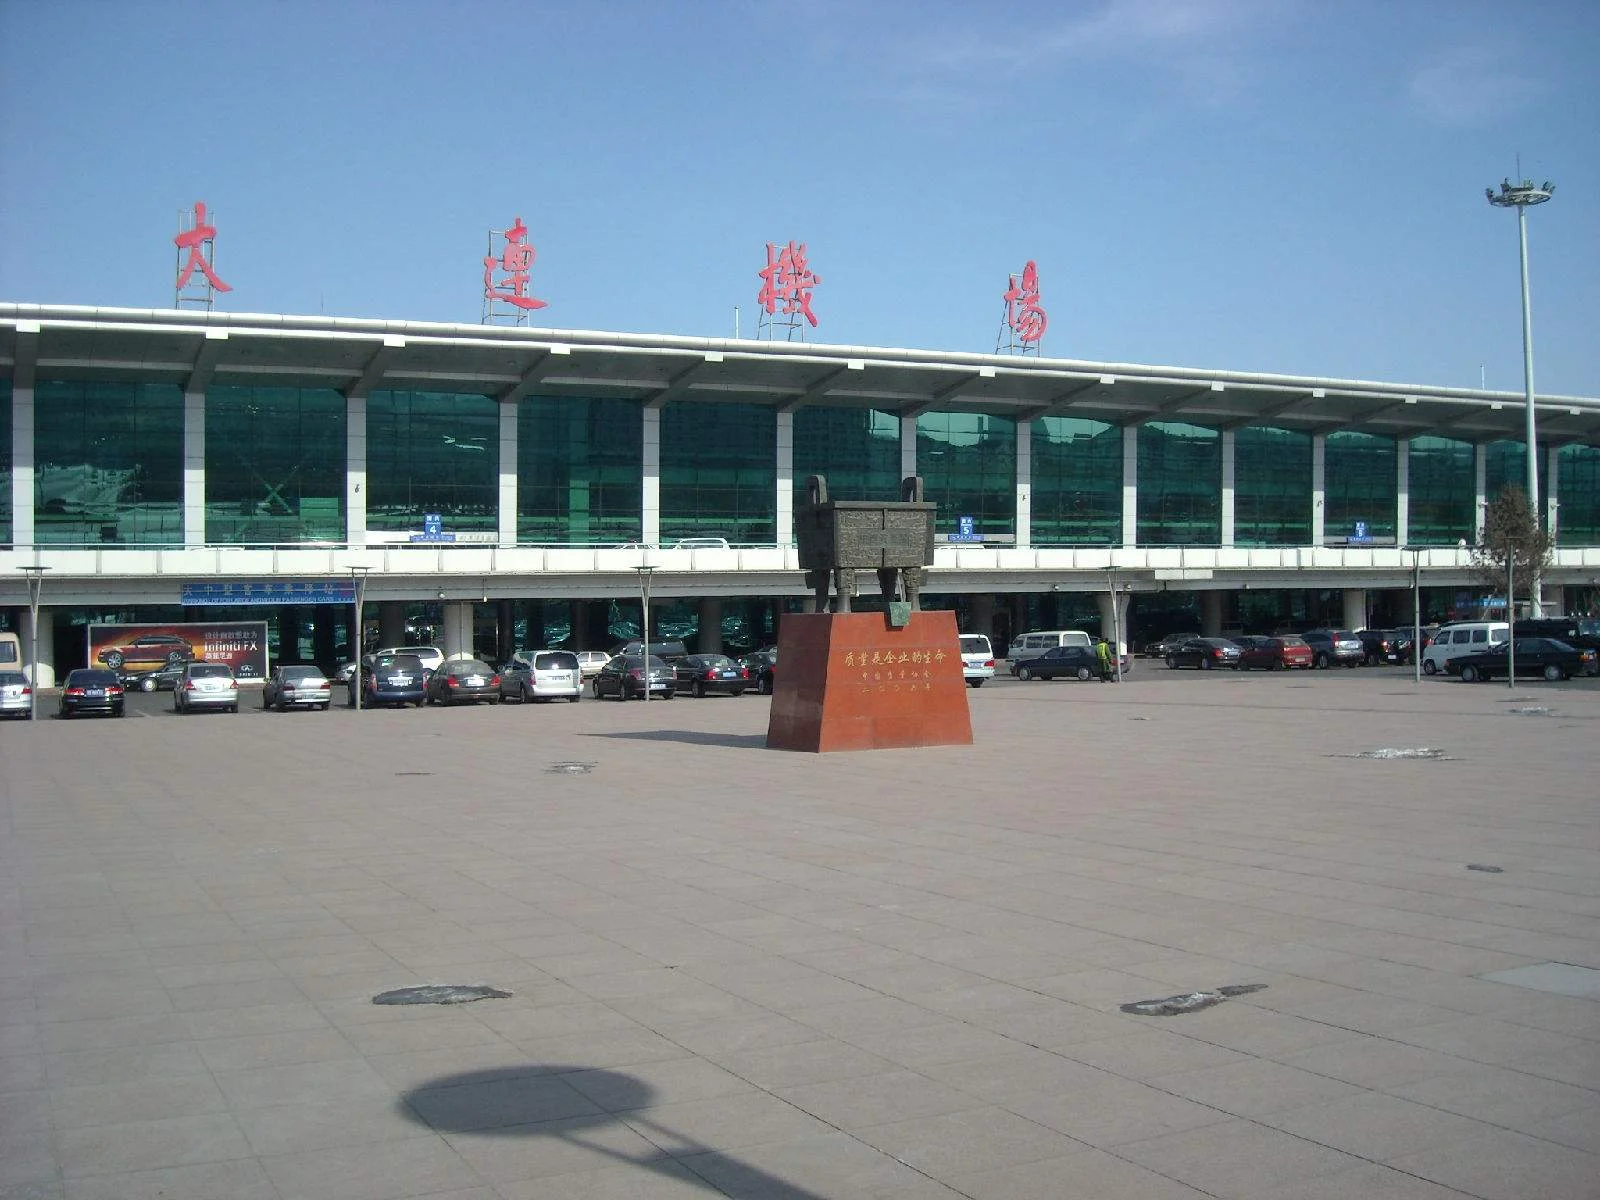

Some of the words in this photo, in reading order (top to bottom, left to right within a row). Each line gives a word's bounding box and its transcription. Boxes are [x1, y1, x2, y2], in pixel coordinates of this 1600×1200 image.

[429, 525, 437, 534] 4
[963, 526, 970, 535] 5
[244, 641, 258, 651] FX
